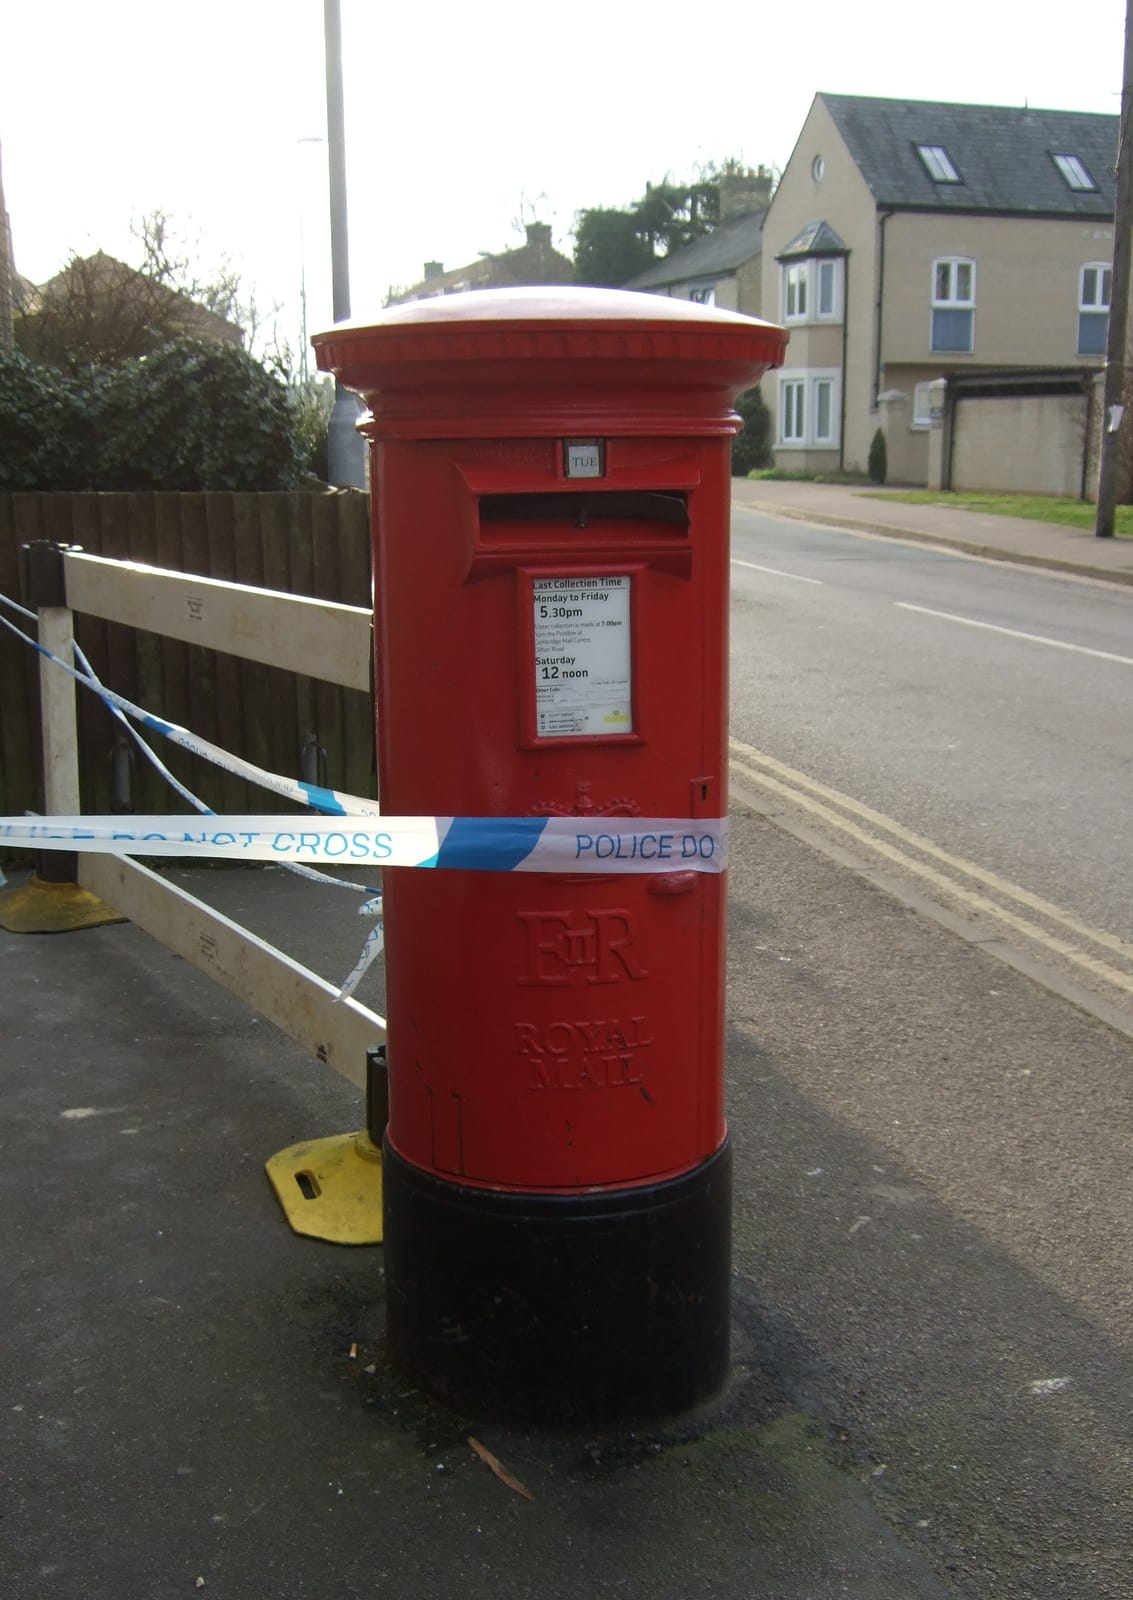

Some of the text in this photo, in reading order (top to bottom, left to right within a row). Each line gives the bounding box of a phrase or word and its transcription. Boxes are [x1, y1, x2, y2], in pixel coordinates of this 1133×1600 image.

[572, 456, 598, 467] TUE
[533, 578, 622, 590] Last Collection Time
[533, 594, 568, 603] Monday
[581, 592, 609, 601] Friday
[540, 605, 583, 619] 5.30pm
[535, 656, 576, 665] Saturday
[541, 666, 589, 680] 12 noon
[272, 832, 393, 858] CROSS
[575, 834, 674, 859] POLICE
[681, 834, 715, 859] DO
[514, 1016, 654, 1054] ROYAL
[528, 1053, 644, 1091] MAIL
